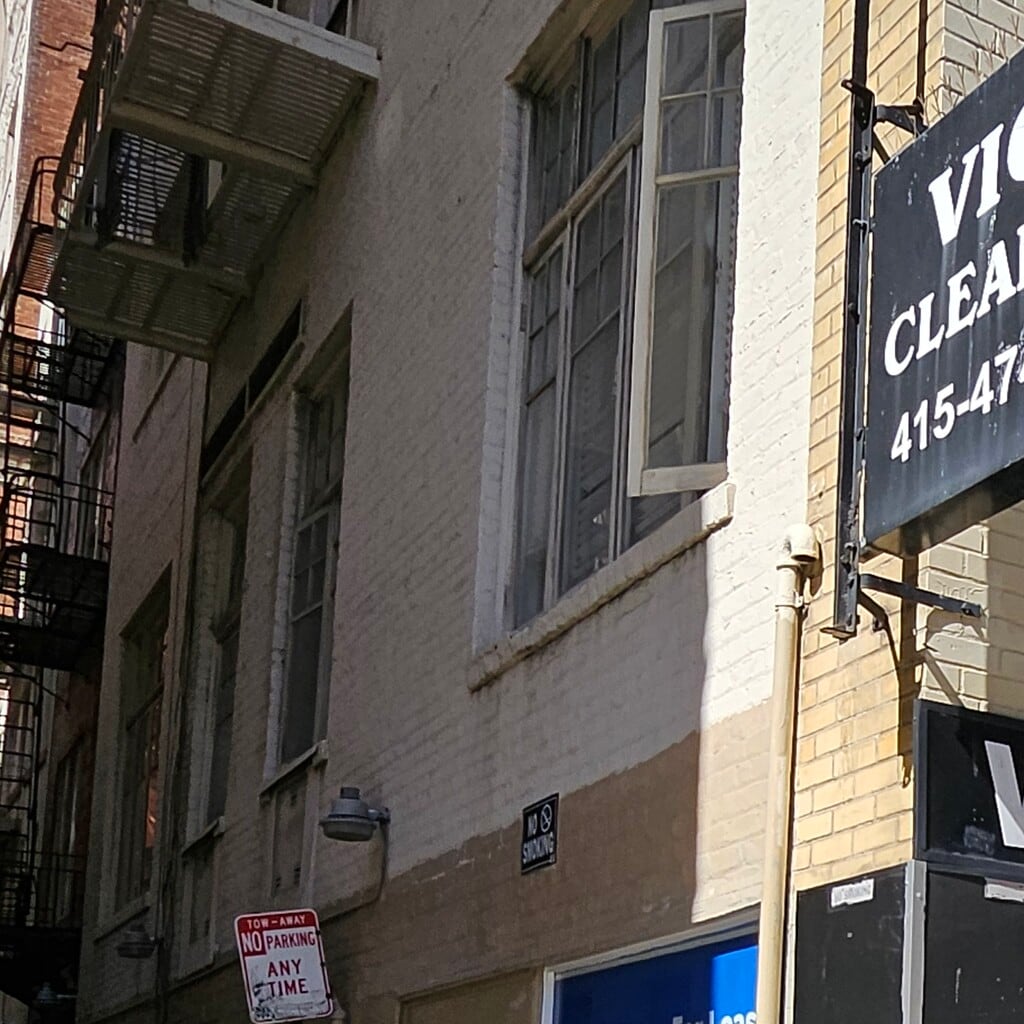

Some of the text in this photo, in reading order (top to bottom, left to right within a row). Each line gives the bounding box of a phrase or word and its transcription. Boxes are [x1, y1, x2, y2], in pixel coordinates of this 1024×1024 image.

[247, 915, 305, 929] TOW-AWAY
[241, 931, 315, 952] NO PARKING
[268, 958, 301, 978] ANY
[268, 979, 308, 997] TIME
